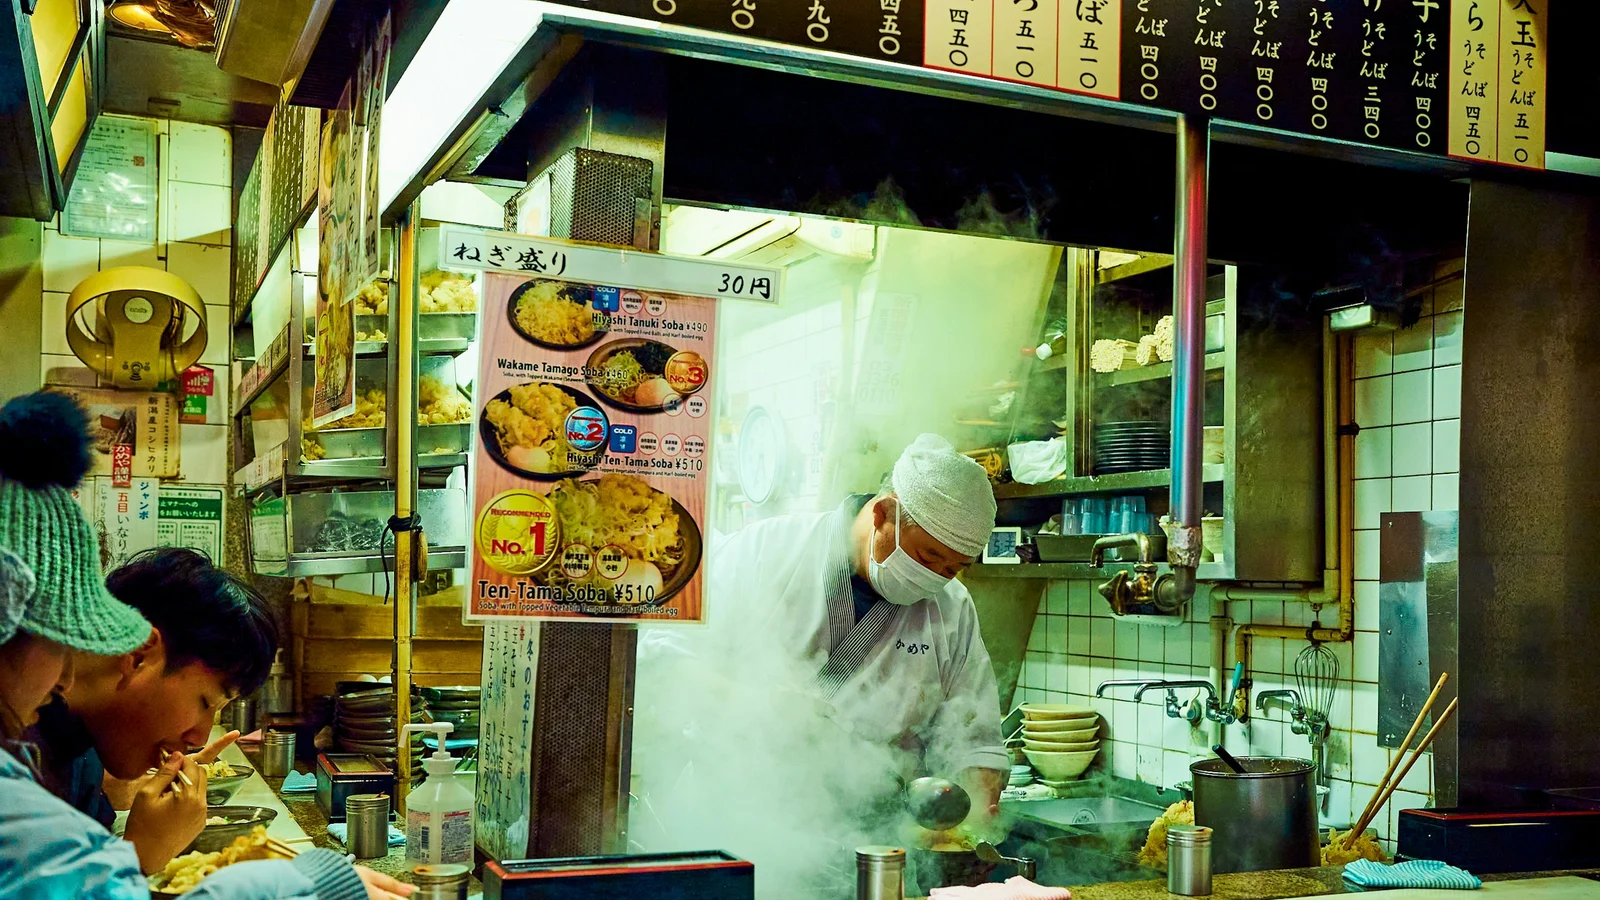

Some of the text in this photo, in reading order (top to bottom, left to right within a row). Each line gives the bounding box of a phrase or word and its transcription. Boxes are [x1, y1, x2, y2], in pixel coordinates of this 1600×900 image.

[949, 8, 969, 66] 四五〇
[1016, 20, 1035, 78] 五一〇
[1079, 32, 1098, 88] 五一〇
[1140, 45, 1159, 100] 四〇〇
[1200, 56, 1217, 110] 四〇〇
[1257, 67, 1273, 120] 四〇〇
[1312, 78, 1328, 129] 四〇〇
[1364, 86, 1381, 138] 三四〇
[1416, 97, 1431, 147] 四〇〇
[1466, 106, 1480, 154] 四五〇
[1514, 113, 1529, 162] 五一〇
[454, 242, 771, 299] ねぎ盛り 30円
[592, 313, 708, 332] Hiyashi Tanuki Soba ¥490
[498, 358, 538, 372] Wakame
[542, 362, 578, 376] Tamago
[581, 365, 603, 377] Soba
[148, 396, 158, 473] 新潟産コシヒカリ
[567, 452, 703, 471] Hiyashi Ten-Tama Soba ¥510
[139, 482, 149, 520] ジャンボ
[479, 581, 655, 603] Ten-Tama Soba ¥510
[479, 601, 498, 610] Soba,
[519, 602, 543, 611] Topped
[545, 603, 580, 613] Vegetable
[666, 608, 678, 616] egg
[896, 639, 929, 654] かめや
